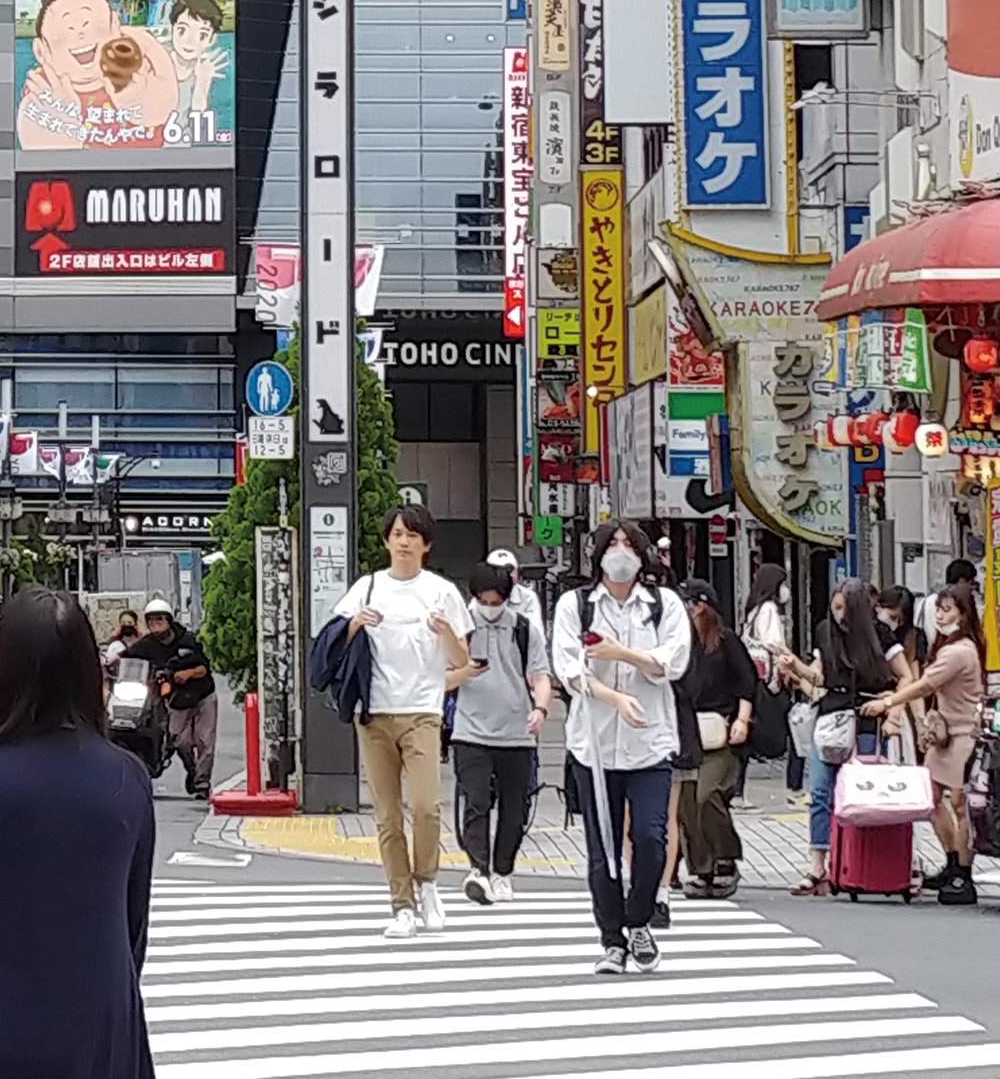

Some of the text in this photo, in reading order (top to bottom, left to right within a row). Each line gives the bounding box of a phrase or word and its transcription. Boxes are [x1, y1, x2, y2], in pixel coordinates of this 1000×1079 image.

[162, 110, 216, 144] 6.11
[586, 121, 619, 142] 4F
[585, 143, 619, 164] 3F
[86, 187, 222, 223] MARUHAN
[383, 342, 458, 365] TOHO
[773, 341, 820, 512] カラオケ
[254, 445, 287, 457] 12-5
